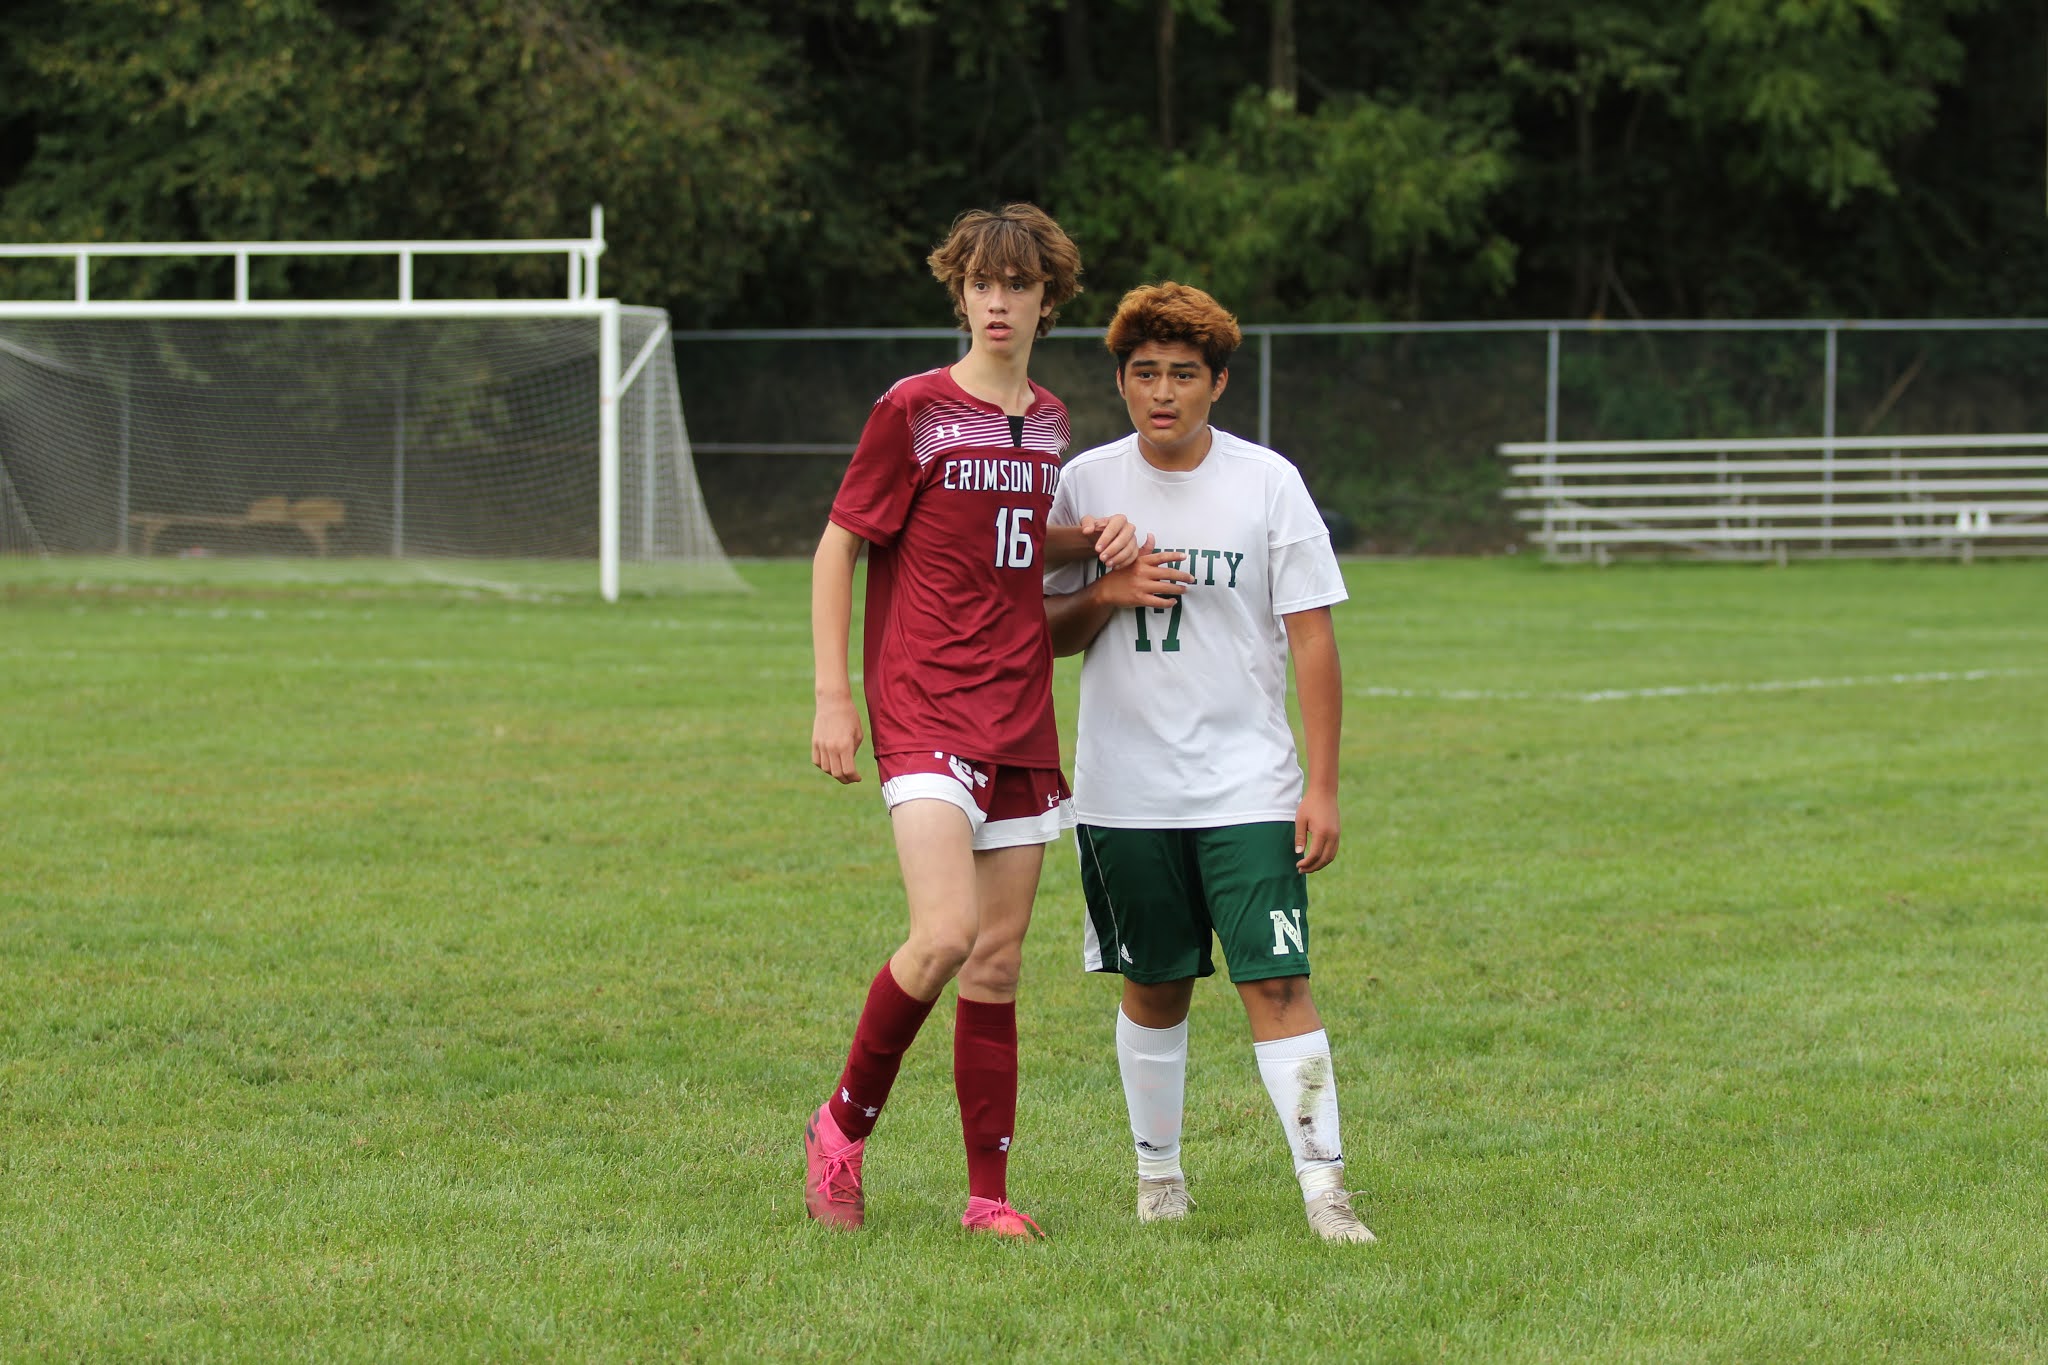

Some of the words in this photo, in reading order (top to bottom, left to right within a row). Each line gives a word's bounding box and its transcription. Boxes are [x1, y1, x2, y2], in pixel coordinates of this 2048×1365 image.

[944, 459, 1032, 492] CRIMSON
[995, 507, 1034, 568] 16
[1135, 592, 1182, 652] 17
[1270, 908, 1304, 955] N
